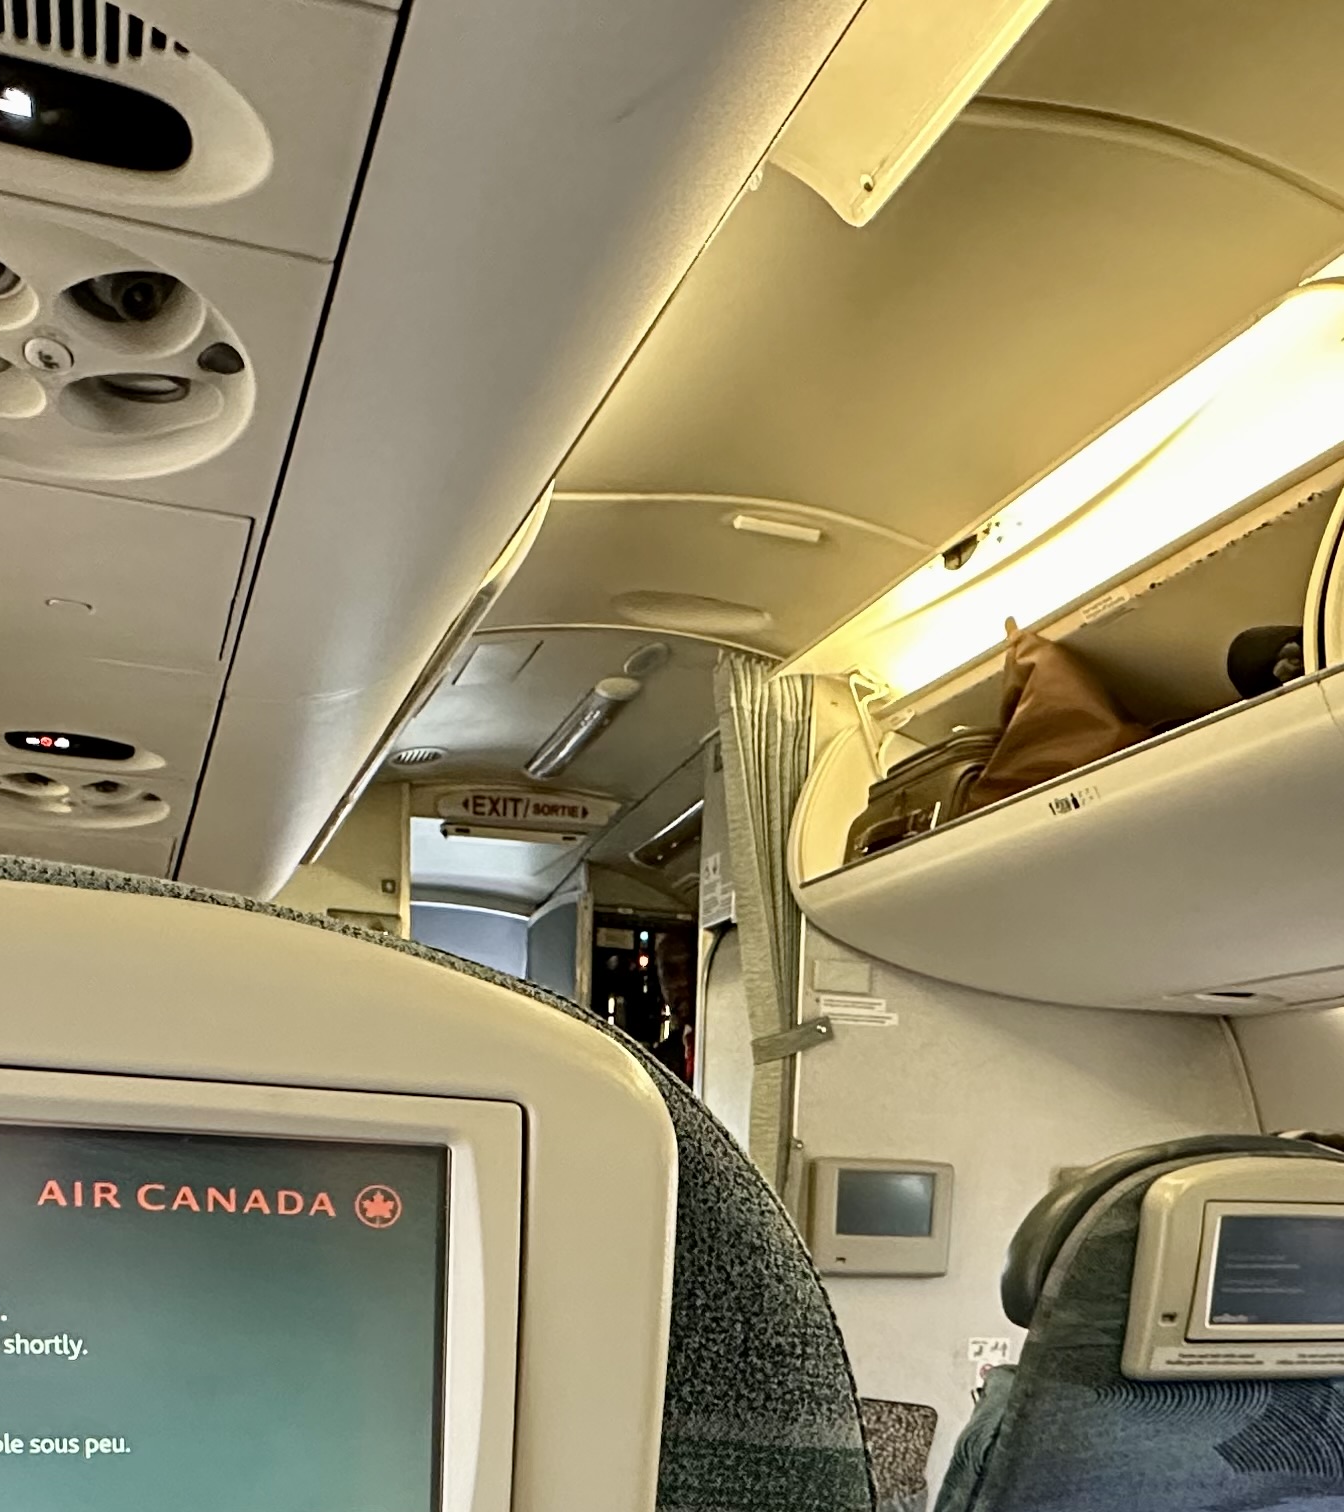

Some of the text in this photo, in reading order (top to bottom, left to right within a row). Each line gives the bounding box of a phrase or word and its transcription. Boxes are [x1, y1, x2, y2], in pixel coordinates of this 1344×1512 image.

[532, 803, 580, 818] SORTIE
[38, 1180, 337, 1217] AIR CANADA
[3, 1334, 88, 1360] shortly.
[29, 1436, 80, 1454] sous
[85, 1437, 131, 1460] peu.
